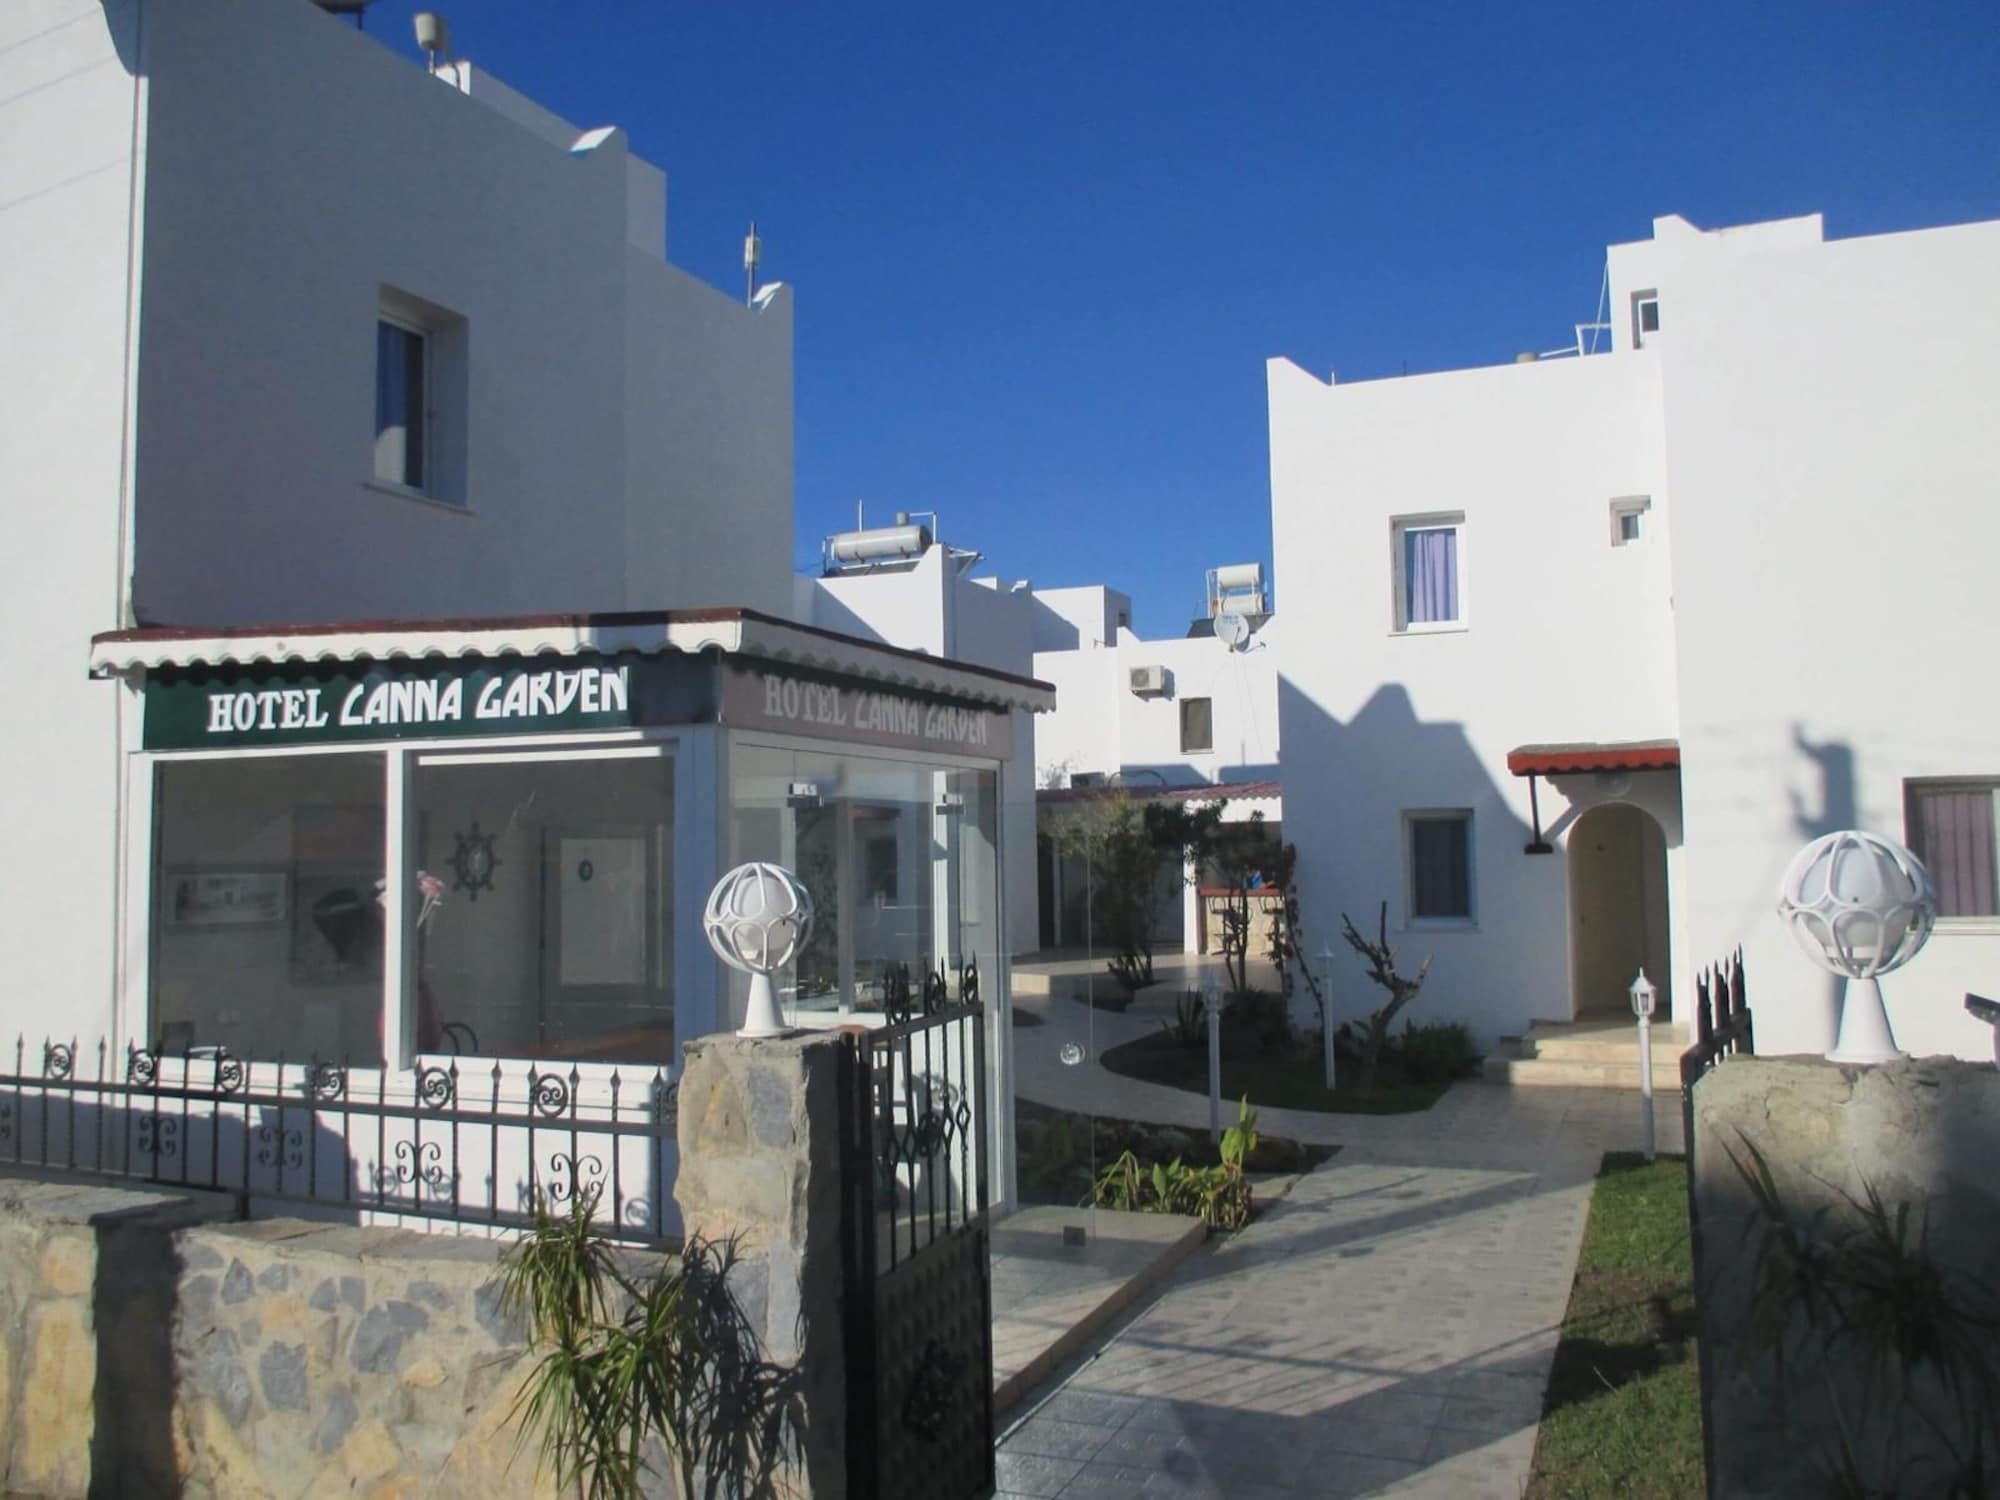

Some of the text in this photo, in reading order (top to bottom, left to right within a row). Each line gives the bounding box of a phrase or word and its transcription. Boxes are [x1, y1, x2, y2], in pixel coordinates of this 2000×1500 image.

[208, 690, 328, 733] HOTEL
[476, 666, 628, 719] GARDEN
[764, 674, 847, 725] HOTEL
[924, 703, 987, 745] GARDEN
